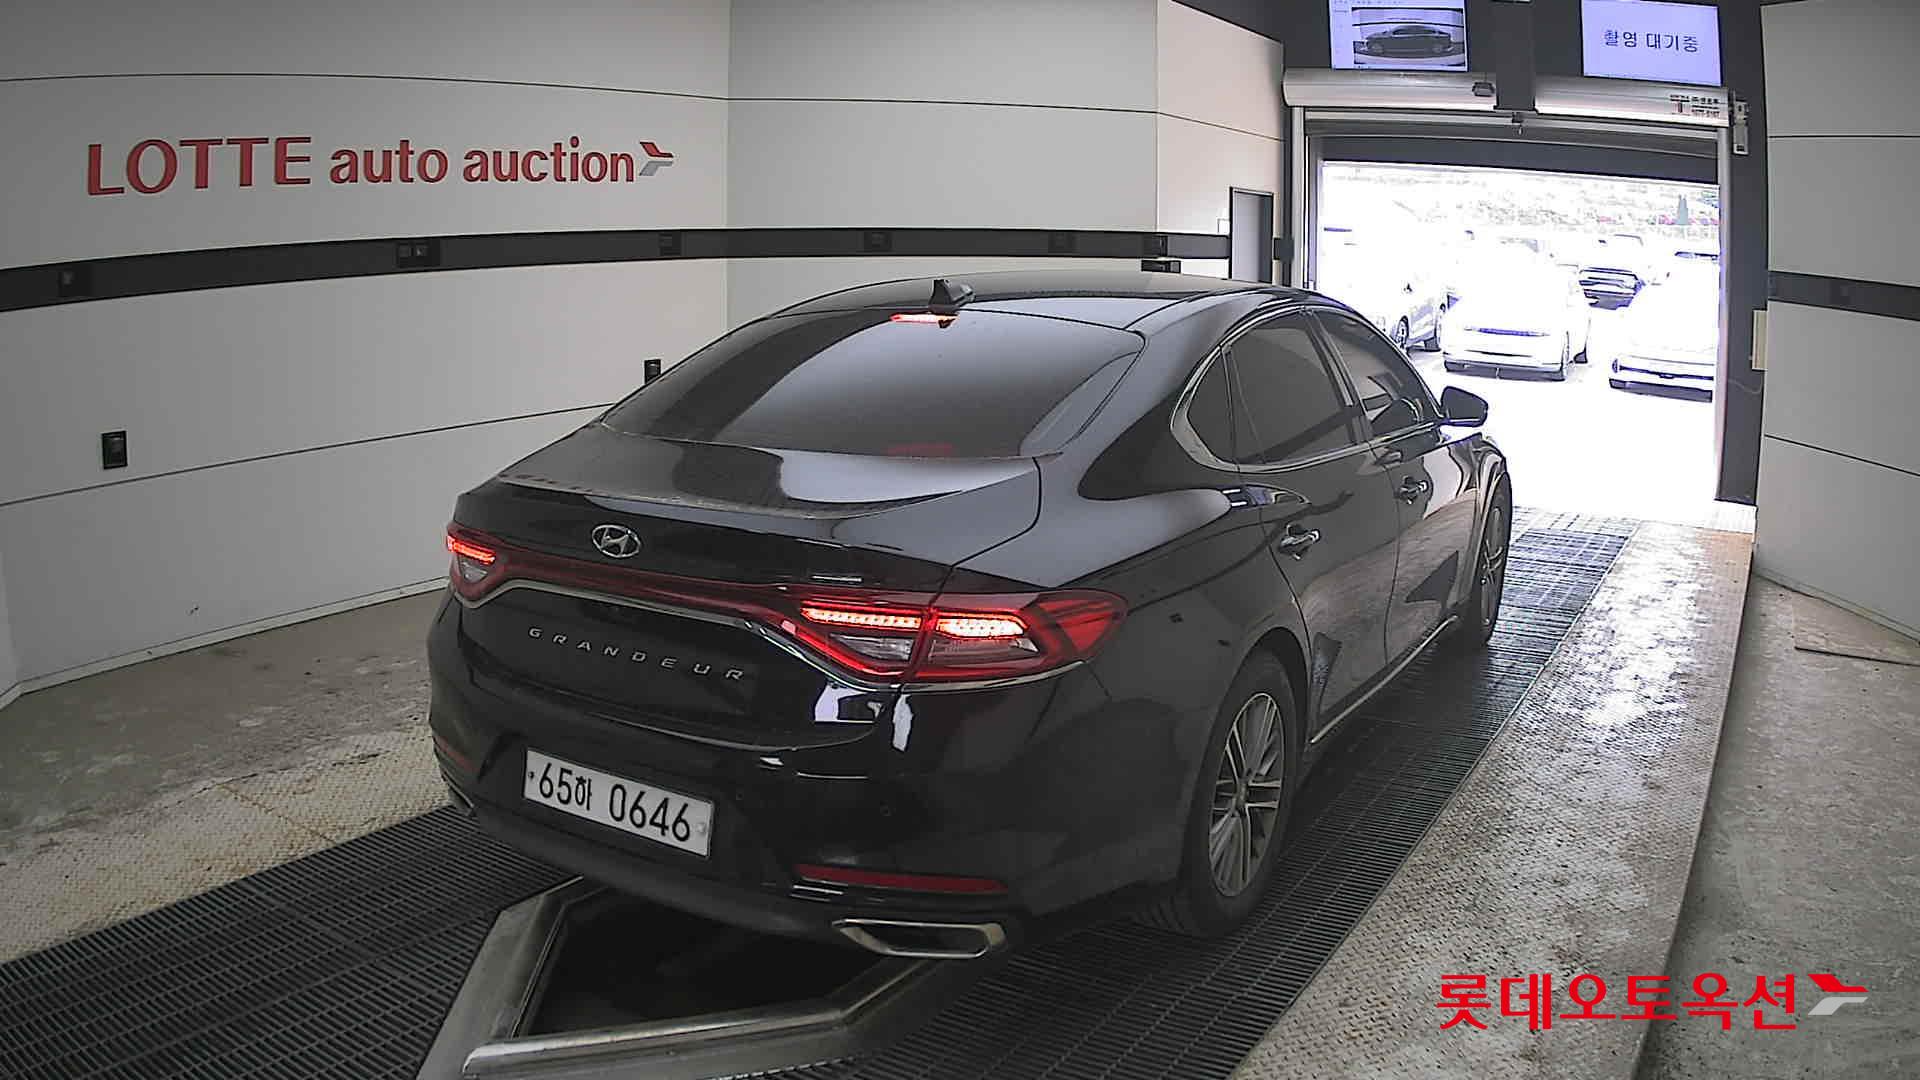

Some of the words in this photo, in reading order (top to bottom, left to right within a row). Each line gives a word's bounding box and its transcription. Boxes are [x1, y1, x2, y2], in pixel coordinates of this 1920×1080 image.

[1646, 33, 1698, 53] 대기중
[87, 136, 312, 196] LOTTE
[329, 139, 449, 185] auto
[463, 136, 634, 185] auction
[529, 627, 745, 681] GRANDEUR
[538, 762, 592, 810] 65하
[608, 783, 692, 842] 0646
